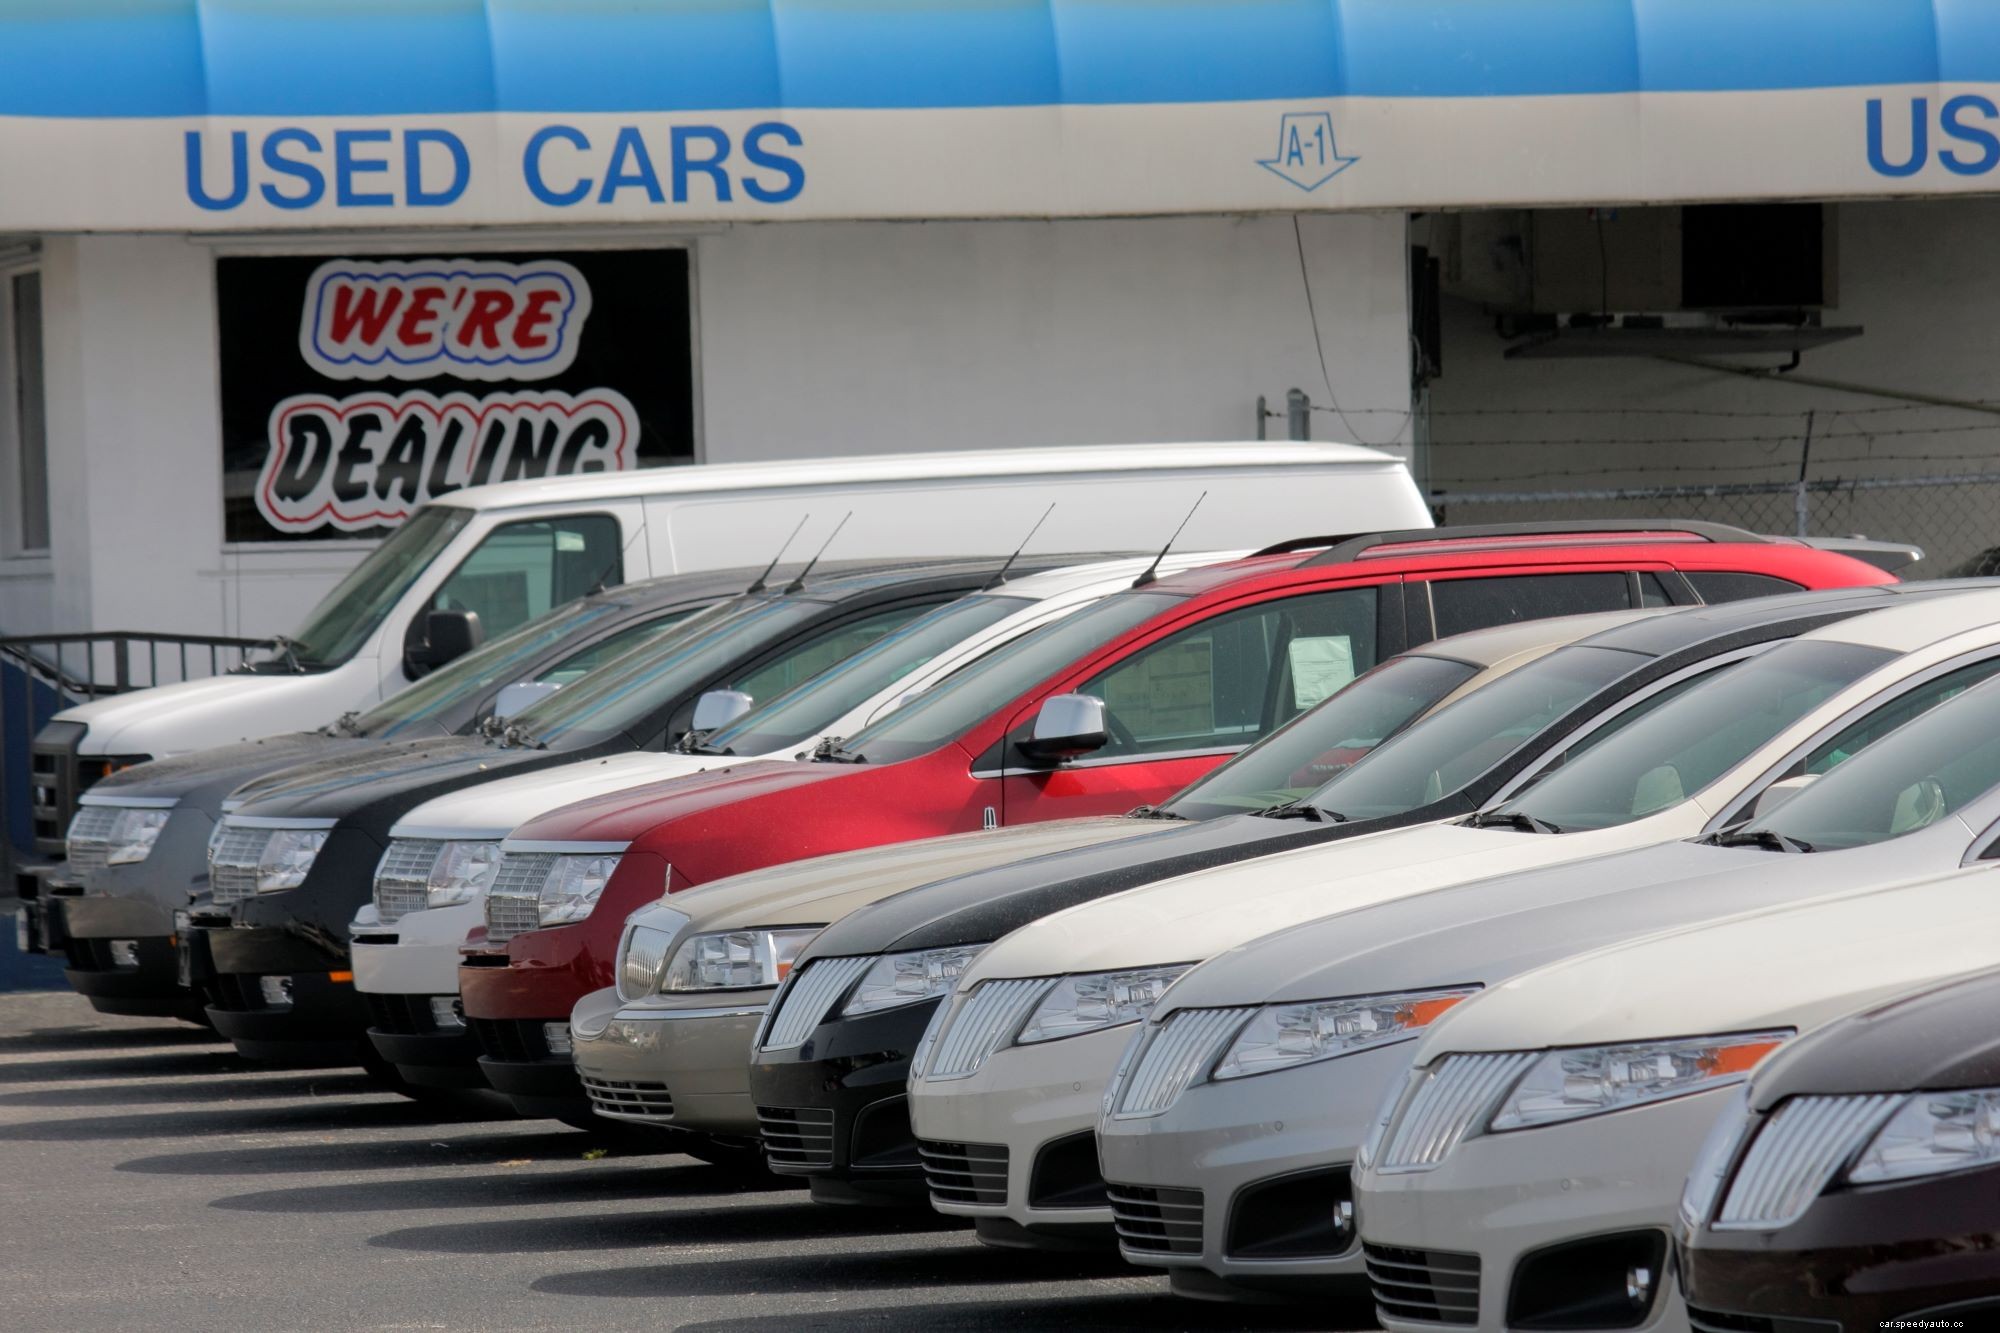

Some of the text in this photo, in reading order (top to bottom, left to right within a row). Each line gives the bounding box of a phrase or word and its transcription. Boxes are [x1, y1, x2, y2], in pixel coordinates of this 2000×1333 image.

[184, 122, 806, 211] USED CARS
[1286, 123, 1325, 167] A-1
[1865, 95, 2000, 177] US
[331, 287, 561, 348] WE'RE
[274, 413, 609, 502] DEALING
